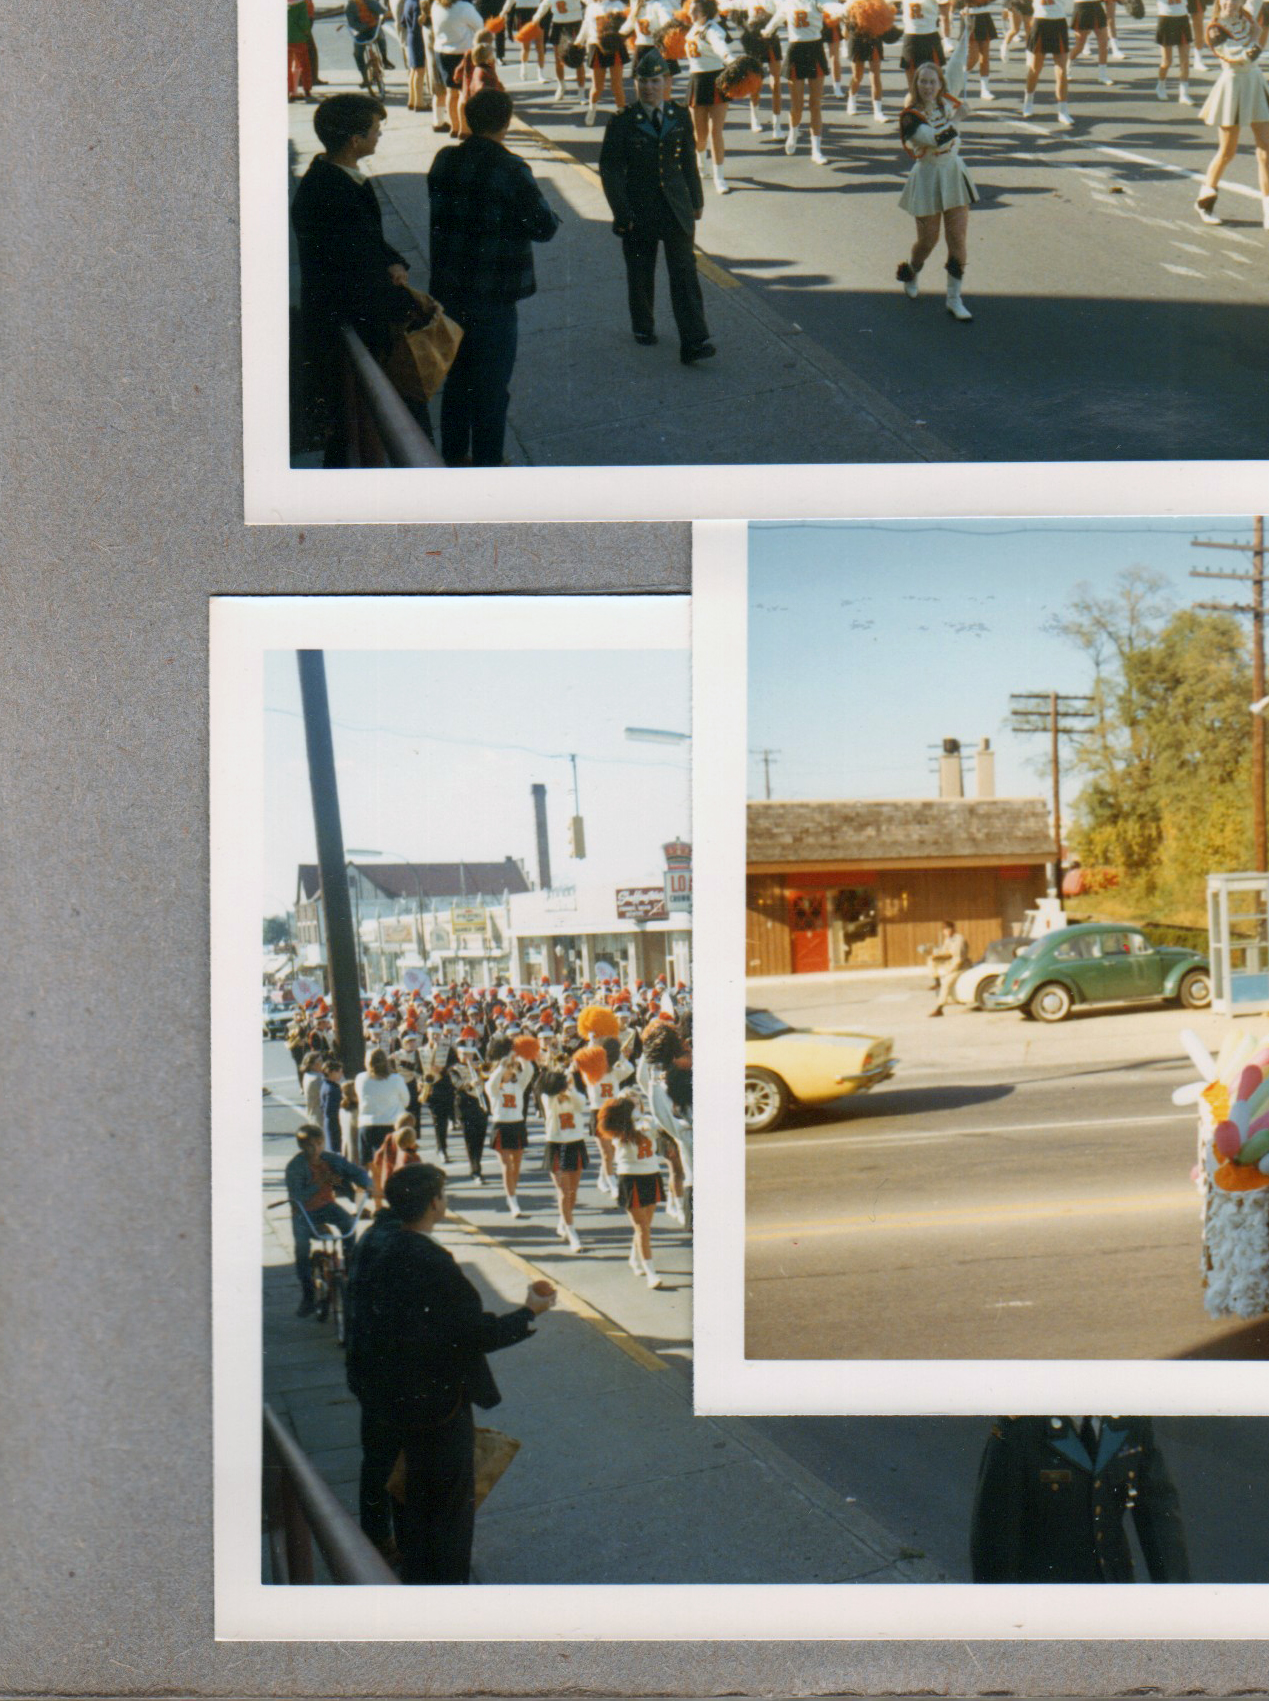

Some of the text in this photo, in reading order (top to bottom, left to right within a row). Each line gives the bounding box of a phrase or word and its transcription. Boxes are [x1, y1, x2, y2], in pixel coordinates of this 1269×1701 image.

[794, 10, 810, 28] R
[909, 3, 924, 19] R
[601, 1083, 613, 1098] R
[503, 1094, 517, 1108] R
[559, 1112, 576, 1130] R
[637, 1138, 653, 1160] R
